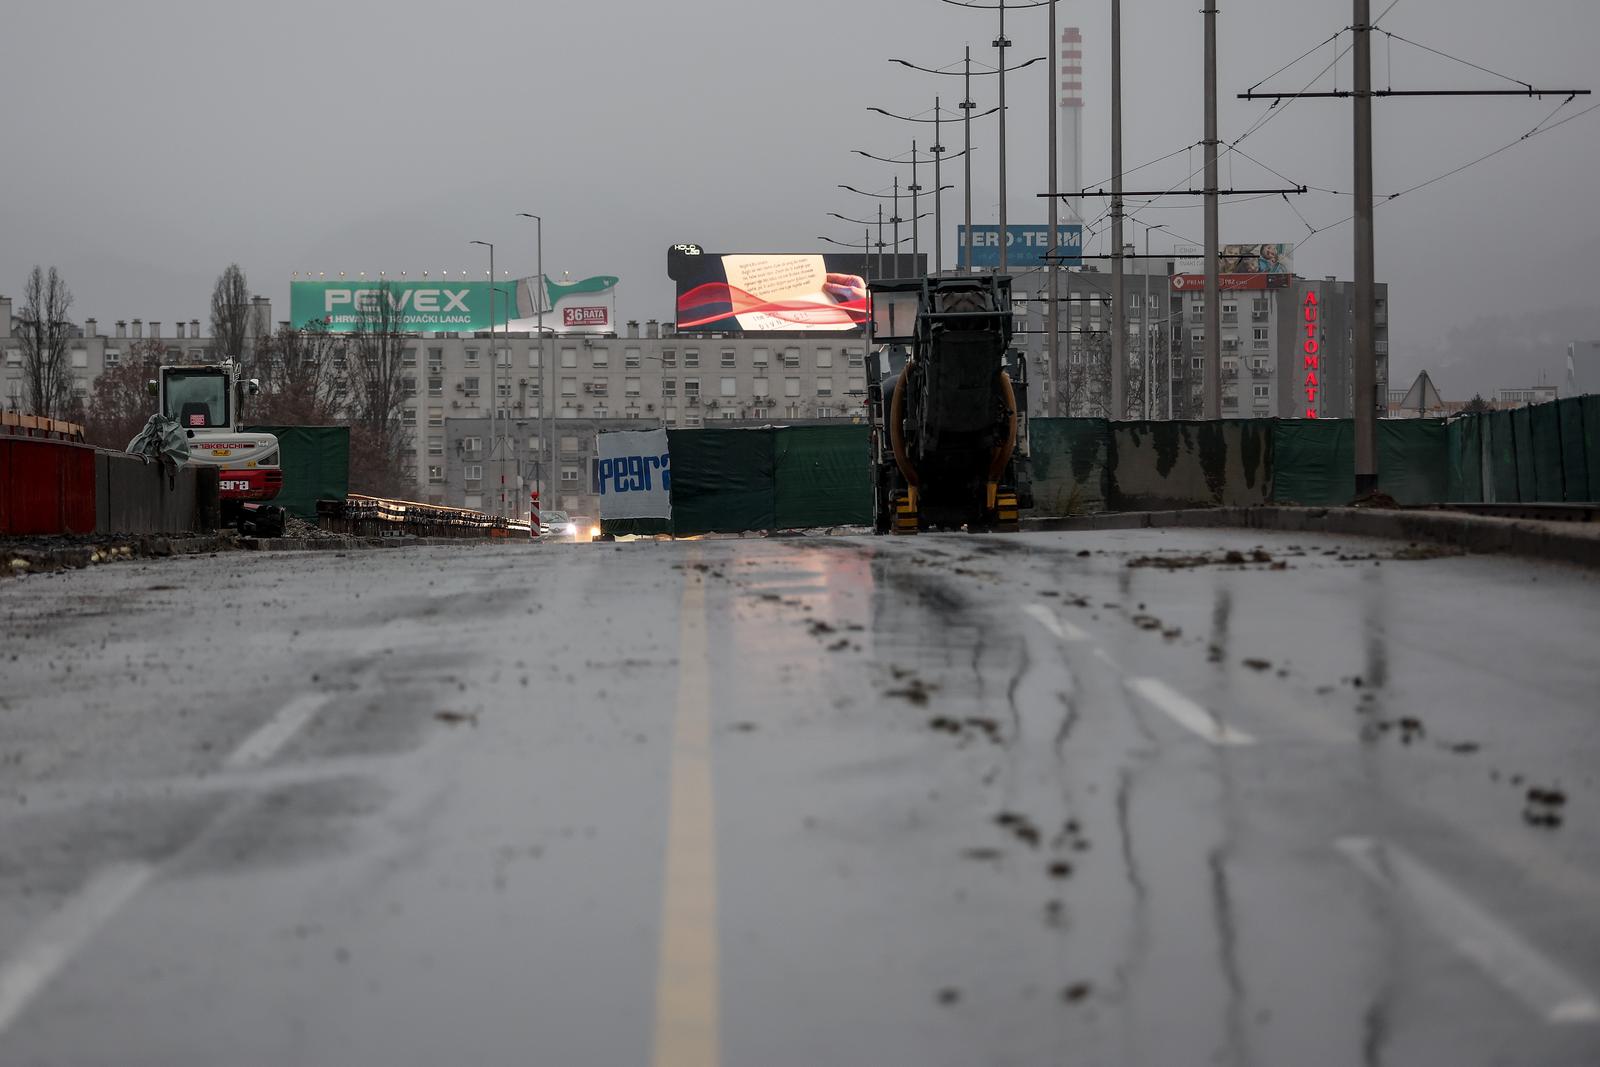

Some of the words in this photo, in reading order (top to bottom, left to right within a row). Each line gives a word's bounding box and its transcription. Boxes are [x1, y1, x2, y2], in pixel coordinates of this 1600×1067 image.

[324, 289, 470, 312] PEVEX
[440, 315, 471, 323] LANAC
[566, 308, 583, 321] 36
[583, 310, 604, 319] RATA
[1303, 291, 1319, 403] AUTOMAT
